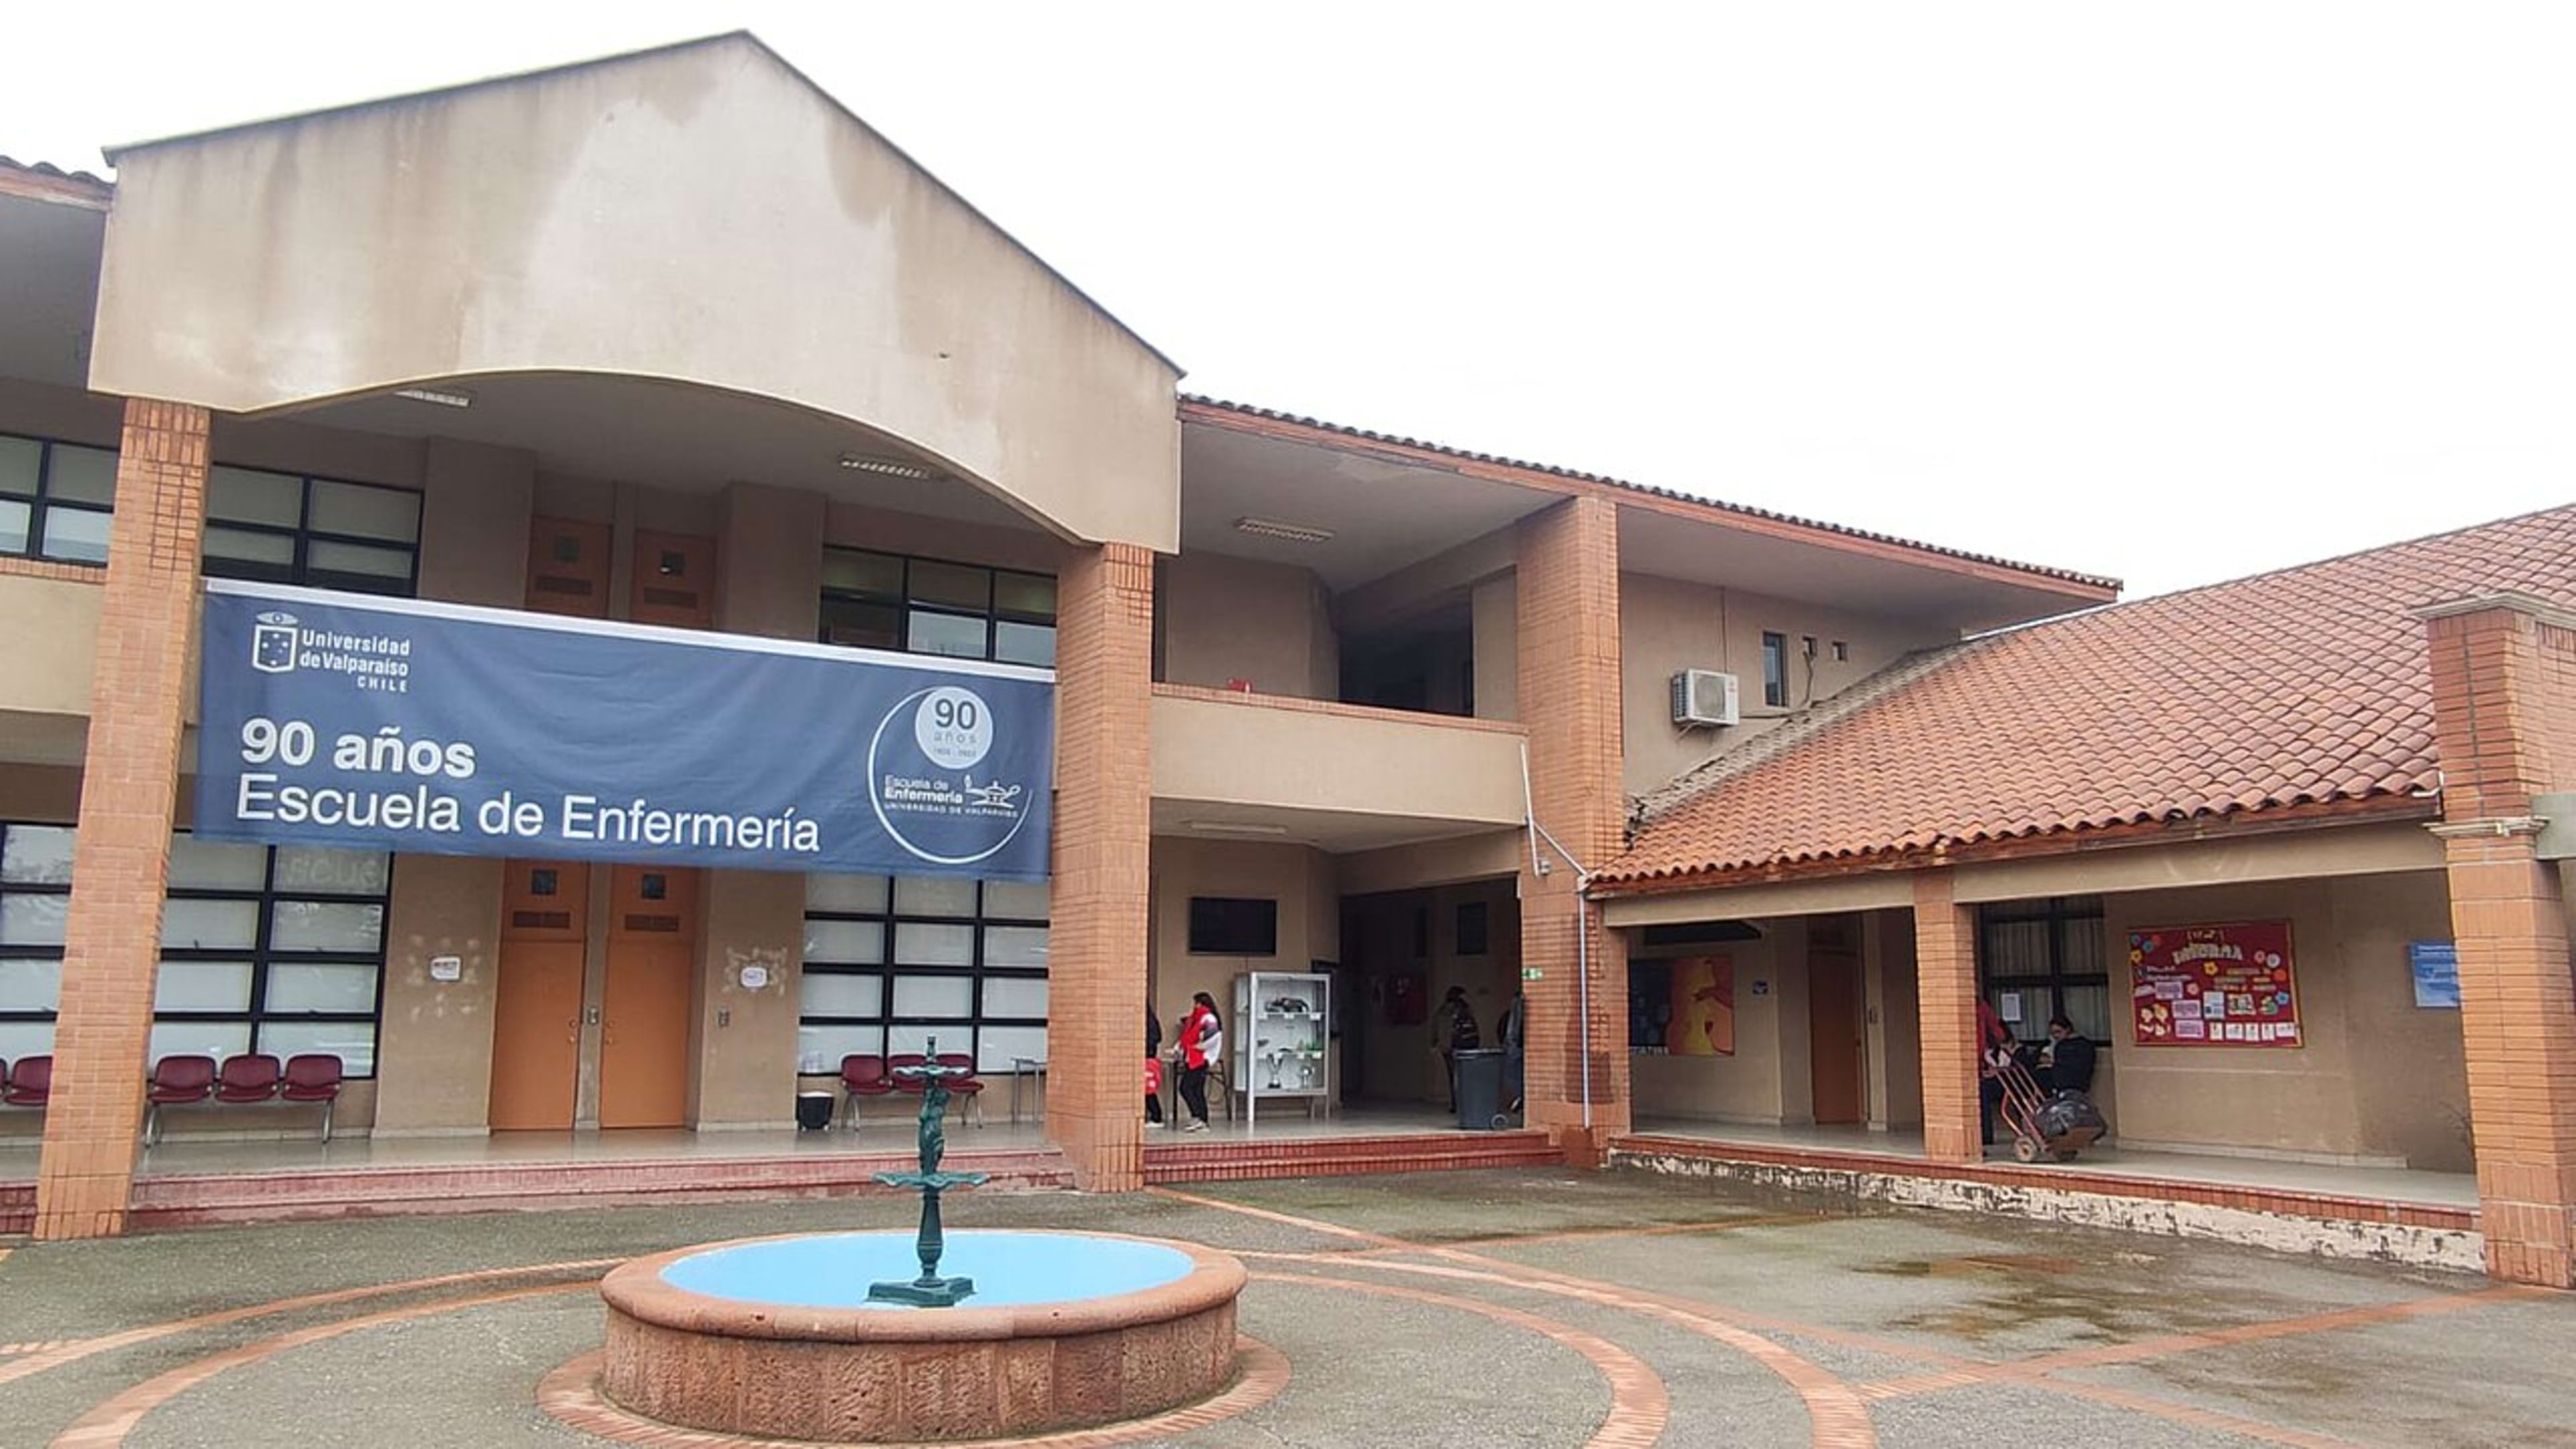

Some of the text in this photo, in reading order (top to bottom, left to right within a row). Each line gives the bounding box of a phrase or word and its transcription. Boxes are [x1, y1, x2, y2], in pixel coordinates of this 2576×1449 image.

[303, 629, 410, 655] Universidad
[300, 650, 408, 677] de Valparaíso
[358, 675, 407, 693] CHILE
[934, 698, 977, 730] 90
[241, 718, 476, 778] 90 años
[884, 786, 963, 804] Enfermería
[885, 774, 949, 791] Escuela de
[237, 773, 820, 852] Escuela de Enfermería
[949, 806, 961, 814] DE
